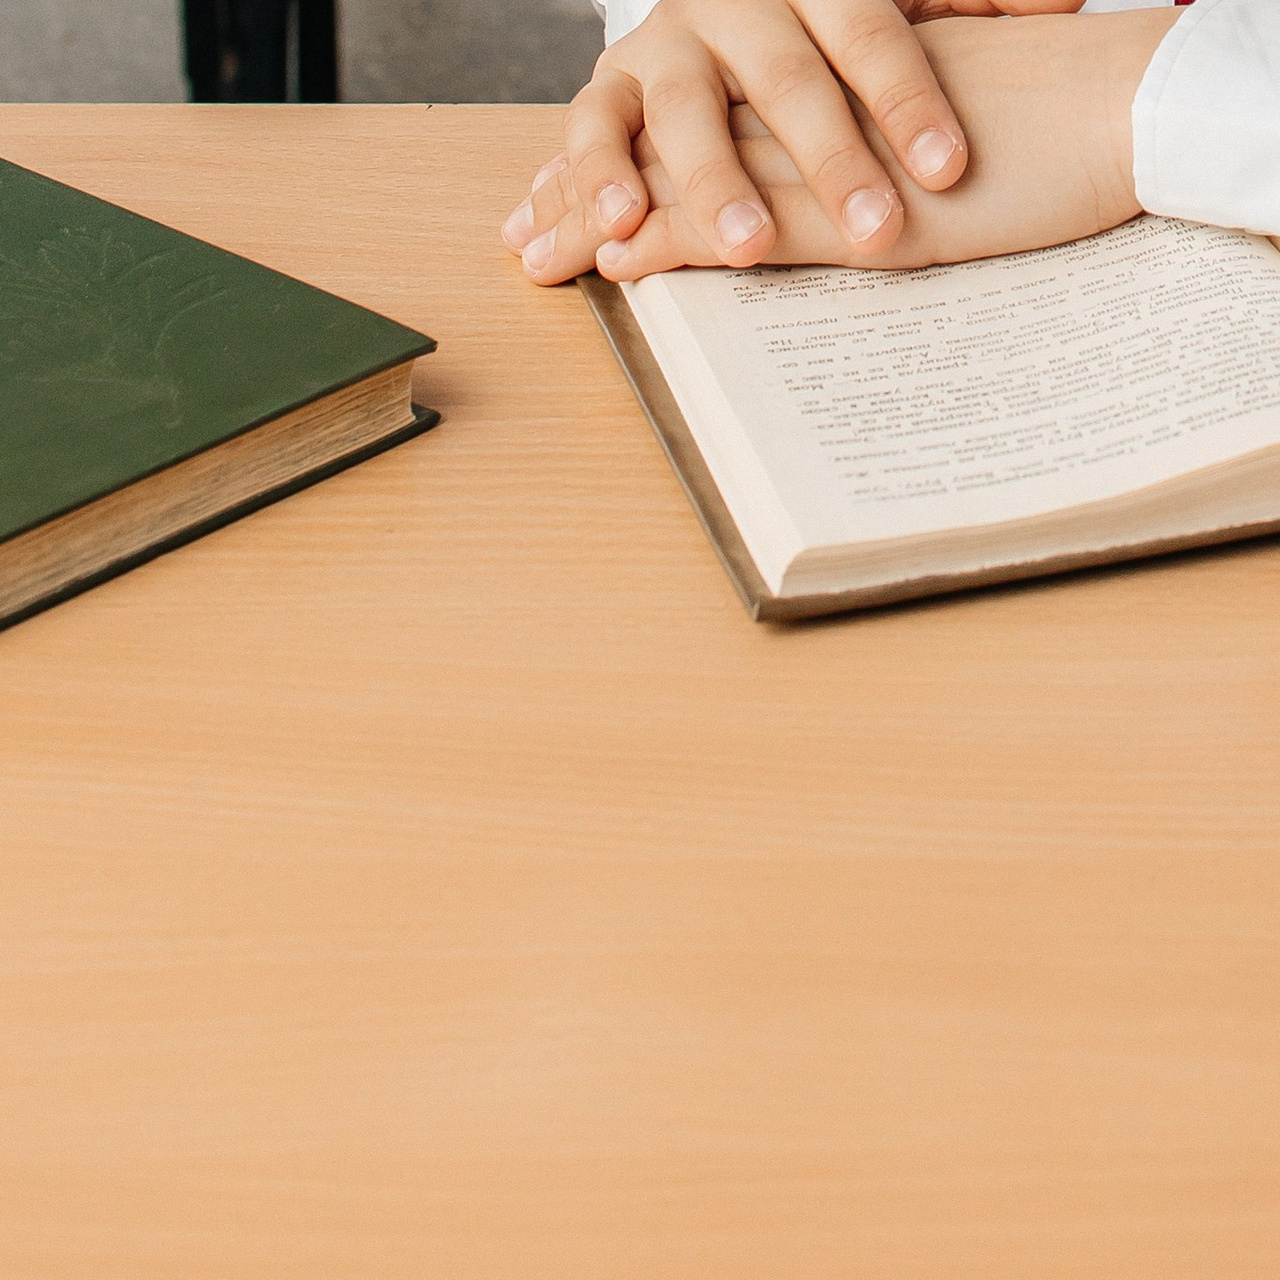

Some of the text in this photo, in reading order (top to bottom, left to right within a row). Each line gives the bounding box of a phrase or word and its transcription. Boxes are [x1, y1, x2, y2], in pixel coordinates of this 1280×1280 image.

[1120, 218, 1146, 230] уж,
[1084, 232, 1113, 244] нет!
[1107, 225, 1158, 243] Тизона
[1175, 234, 1196, 244] Вы
[1064, 221, 1186, 264] Пропустить тебя!
[999, 241, 1100, 270] расхохоталась.
[1004, 242, 1077, 262] Выпустить
[1083, 244, 1167, 271] ошибаетесь,
[1131, 234, 1248, 268] когда! Никогда!
[1147, 259, 1176, 271] Ты?
[1180, 256, 1209, 269] Ты?
[725, 269, 763, 279] Боже
[840, 268, 873, 277] дочь
[910, 270, 952, 282] чтобы
[1114, 270, 1138, 279] Ты
[1175, 266, 1225, 284] Бедная
[1210, 269, 1253, 282] может
[784, 274, 831, 285] умрет,
[1010, 276, 1056, 291] жалею
[1078, 278, 1105, 290] мне
[778, 282, 828, 293] помогу
[818, 283, 875, 296] бежала!
[1082, 277, 1136, 296] сказала
[1149, 281, 1201, 301] спасти?
[736, 290, 768, 299] тебе
[775, 291, 808, 299] Ведь
[979, 289, 1002, 299] вас
[1149, 278, 1243, 309] приговорили?
[909, 301, 947, 311] всего
[966, 289, 1069, 319] сочувствуешь?
[1032, 297, 1066, 311] жена
[1150, 286, 1243, 316] Приговорили
[847, 309, 901, 320] сердца,
[1084, 300, 1141, 318] Значит,
[1110, 307, 1140, 320] Моя
[756, 317, 838, 331] пропустите
[886, 320, 922, 330] меня
[933, 316, 956, 324] Ты
[960, 311, 1019, 326] Тизона,
[1019, 312, 1073, 330] сказала
[804, 328, 875, 343] жалеешь?
[882, 328, 921, 338] глаза
[1013, 319, 1077, 340] слишком
[1052, 320, 1105, 338] Элоиза
[1059, 320, 1125, 345] смертной
[939, 329, 1010, 345] королева,
[767, 342, 836, 353] налились
[807, 357, 834, 366] вам
[919, 353, 972, 366] Значит
[898, 361, 968, 377] крикнула
[802, 373, 834, 382] спас
[788, 383, 824, 391] Мою
